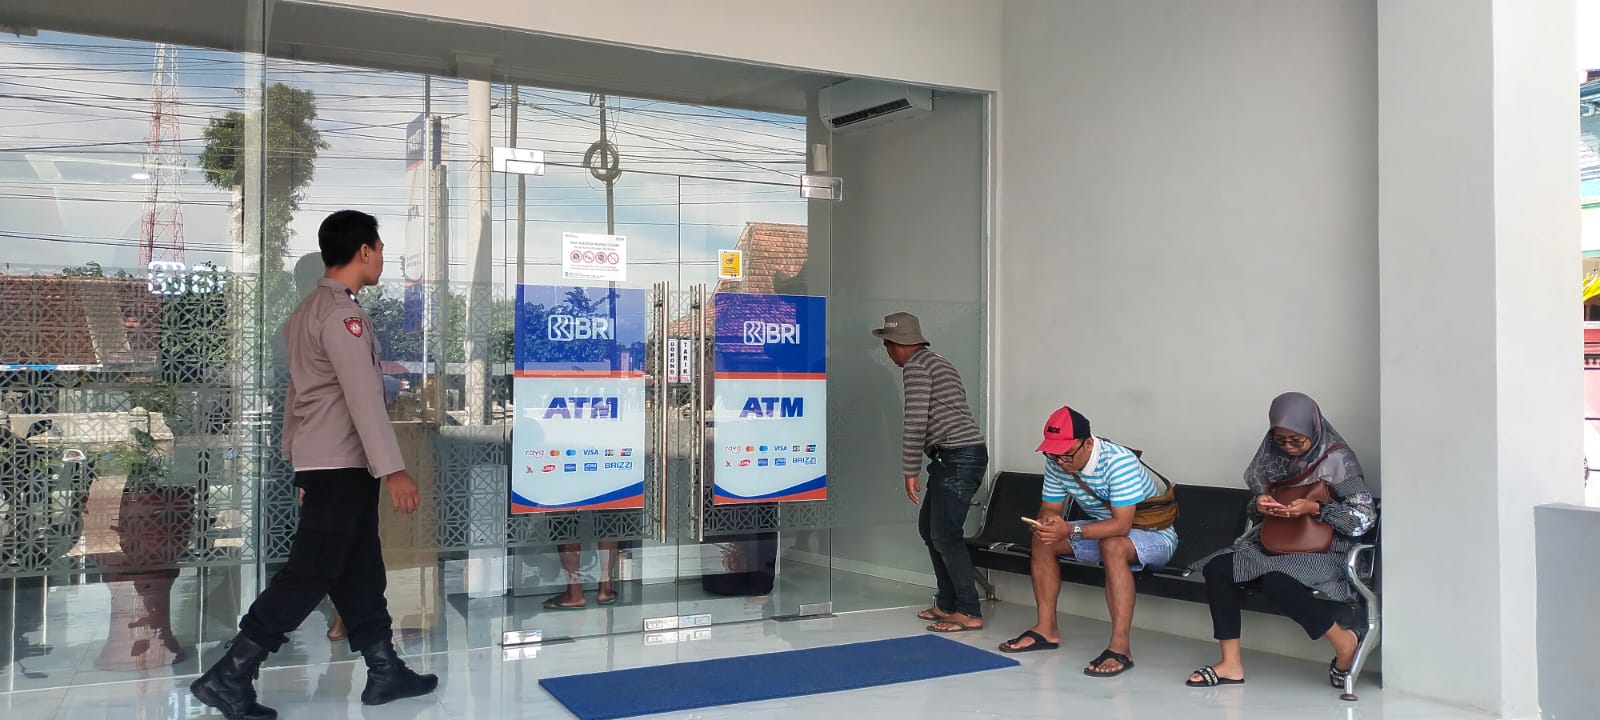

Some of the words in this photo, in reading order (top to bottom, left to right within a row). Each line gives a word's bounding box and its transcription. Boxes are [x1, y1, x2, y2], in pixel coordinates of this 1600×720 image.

[575, 318, 614, 340] BRI
[767, 323, 800, 344] BRI
[543, 396, 618, 419] ATM
[739, 397, 804, 418] ATM
[774, 444, 787, 452] VISA
